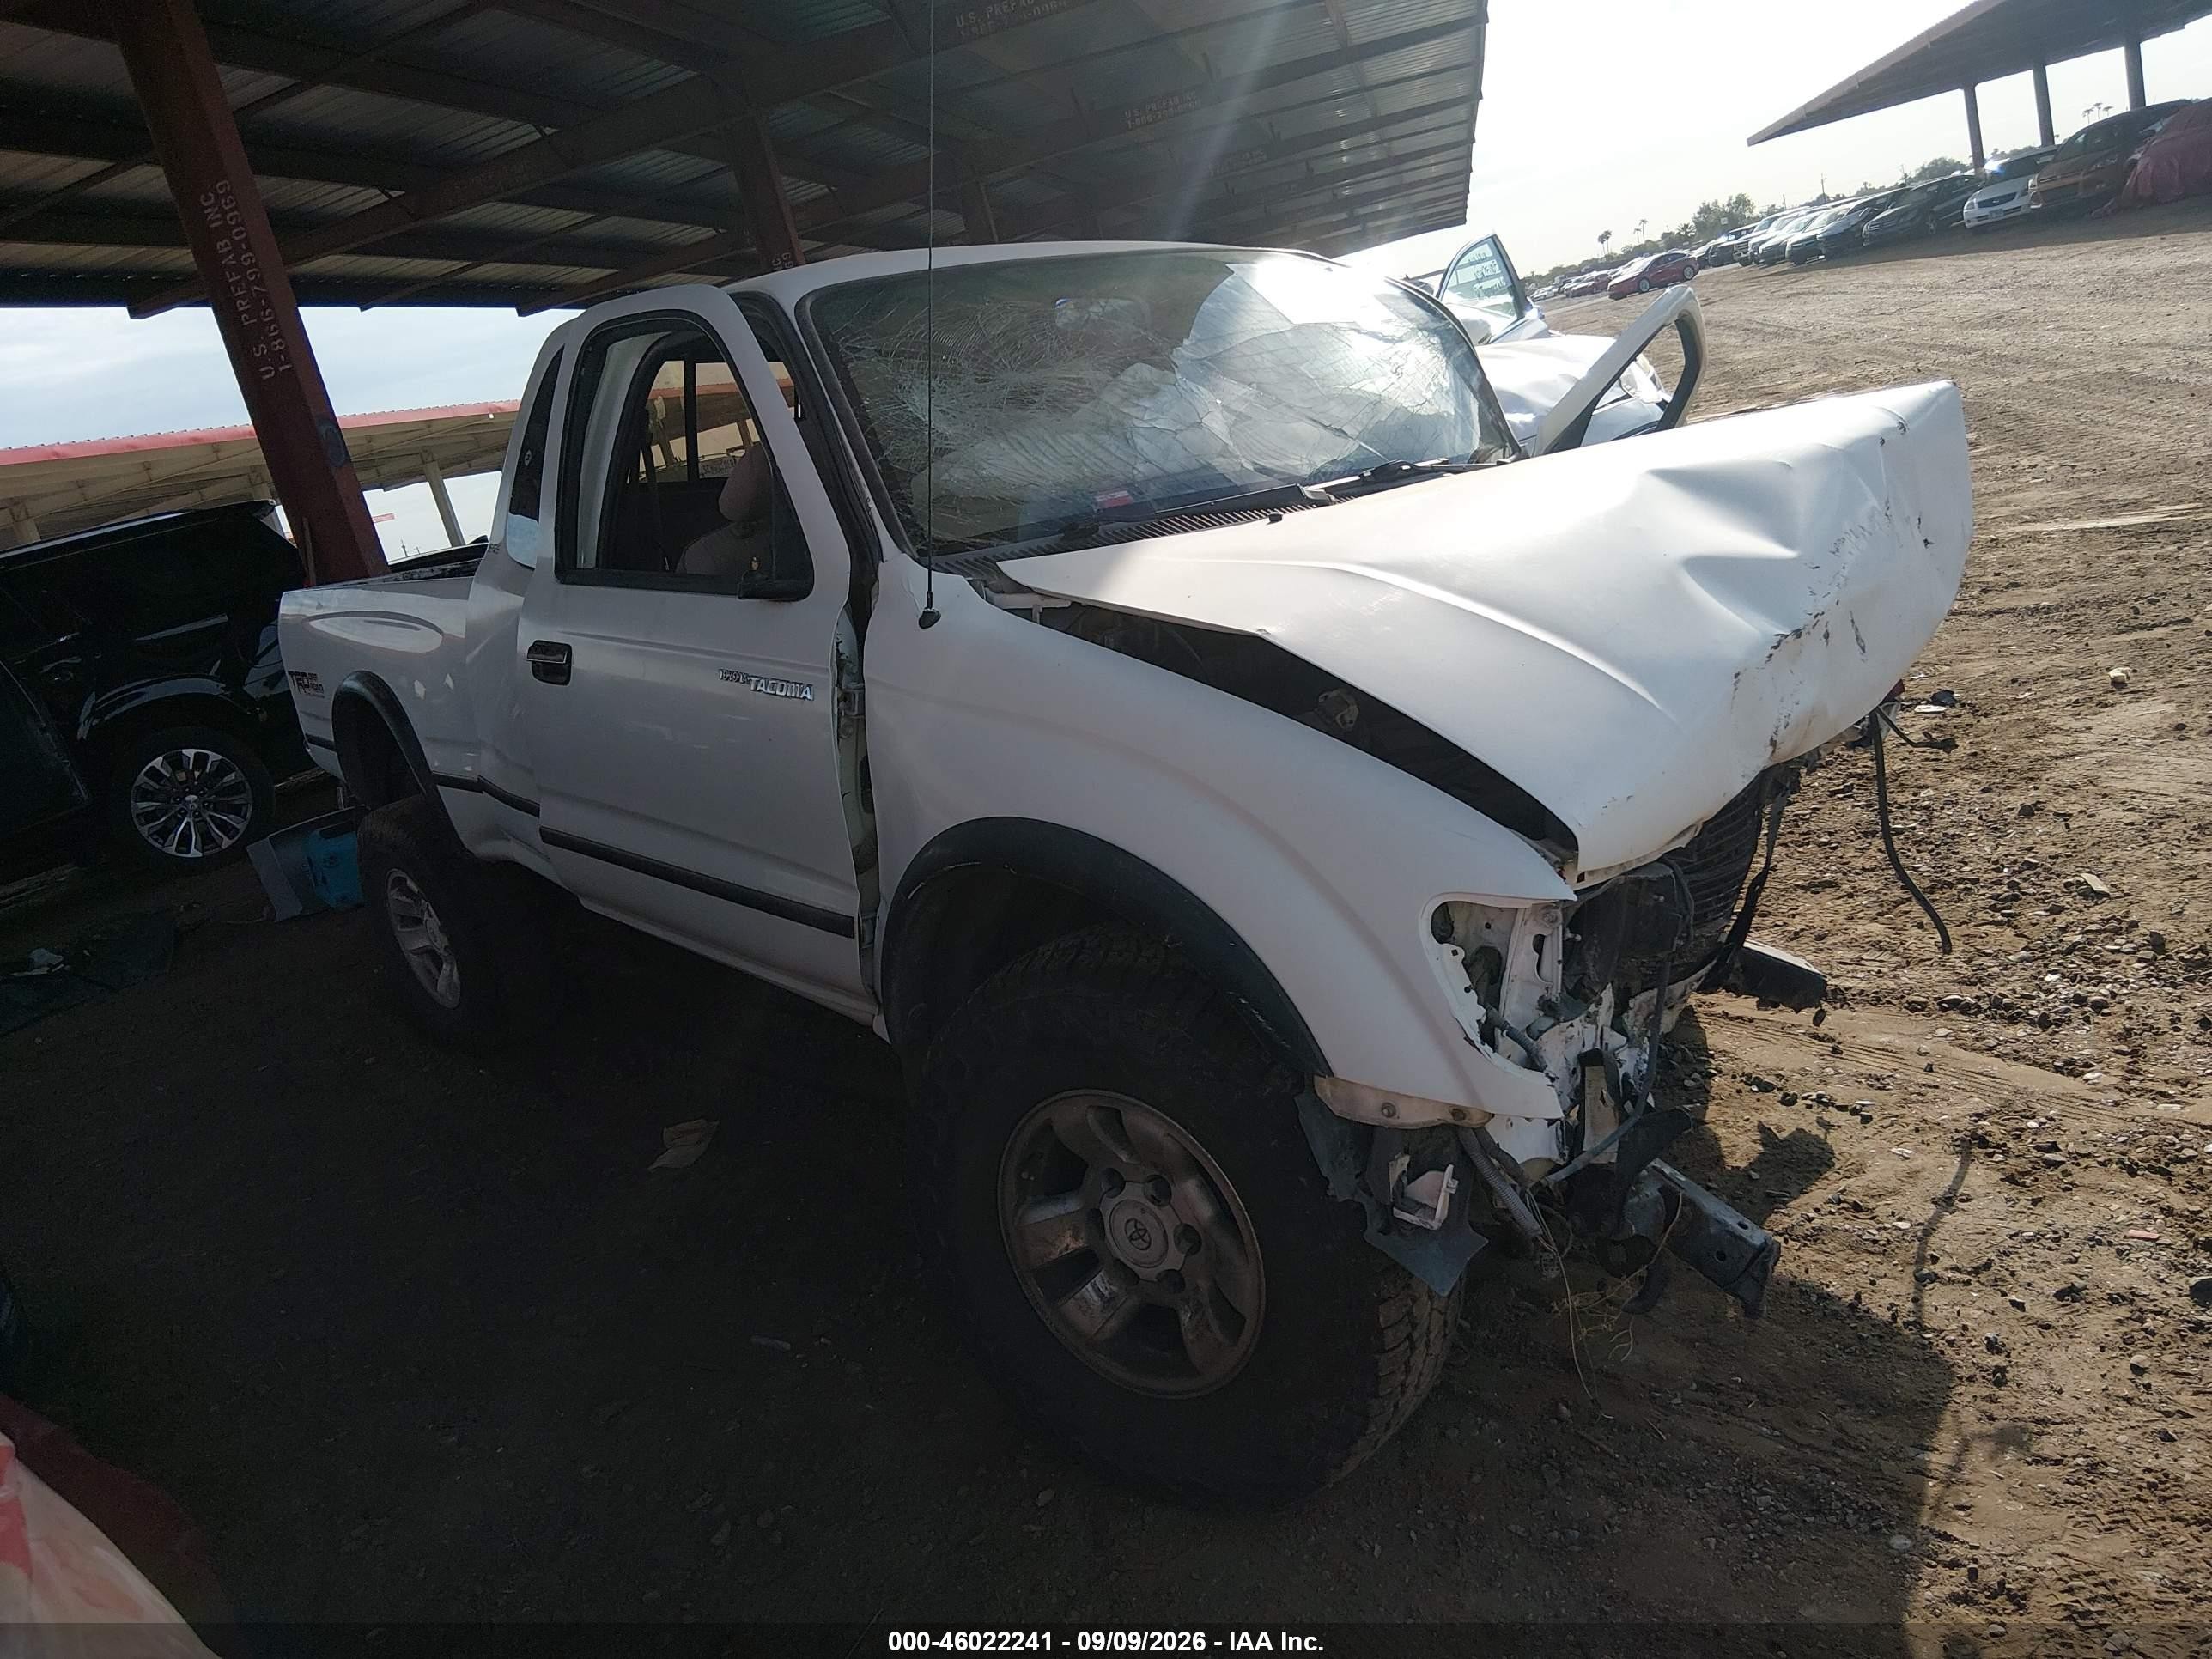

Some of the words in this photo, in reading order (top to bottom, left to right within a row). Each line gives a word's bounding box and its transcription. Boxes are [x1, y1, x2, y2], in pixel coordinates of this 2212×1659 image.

[200, 191, 223, 228] INC
[216, 179, 292, 372] 1-866-799-0969
[216, 240, 258, 325] PREFAB
[253, 336, 275, 380] U.S.
[747, 675, 814, 701] TACOMA
